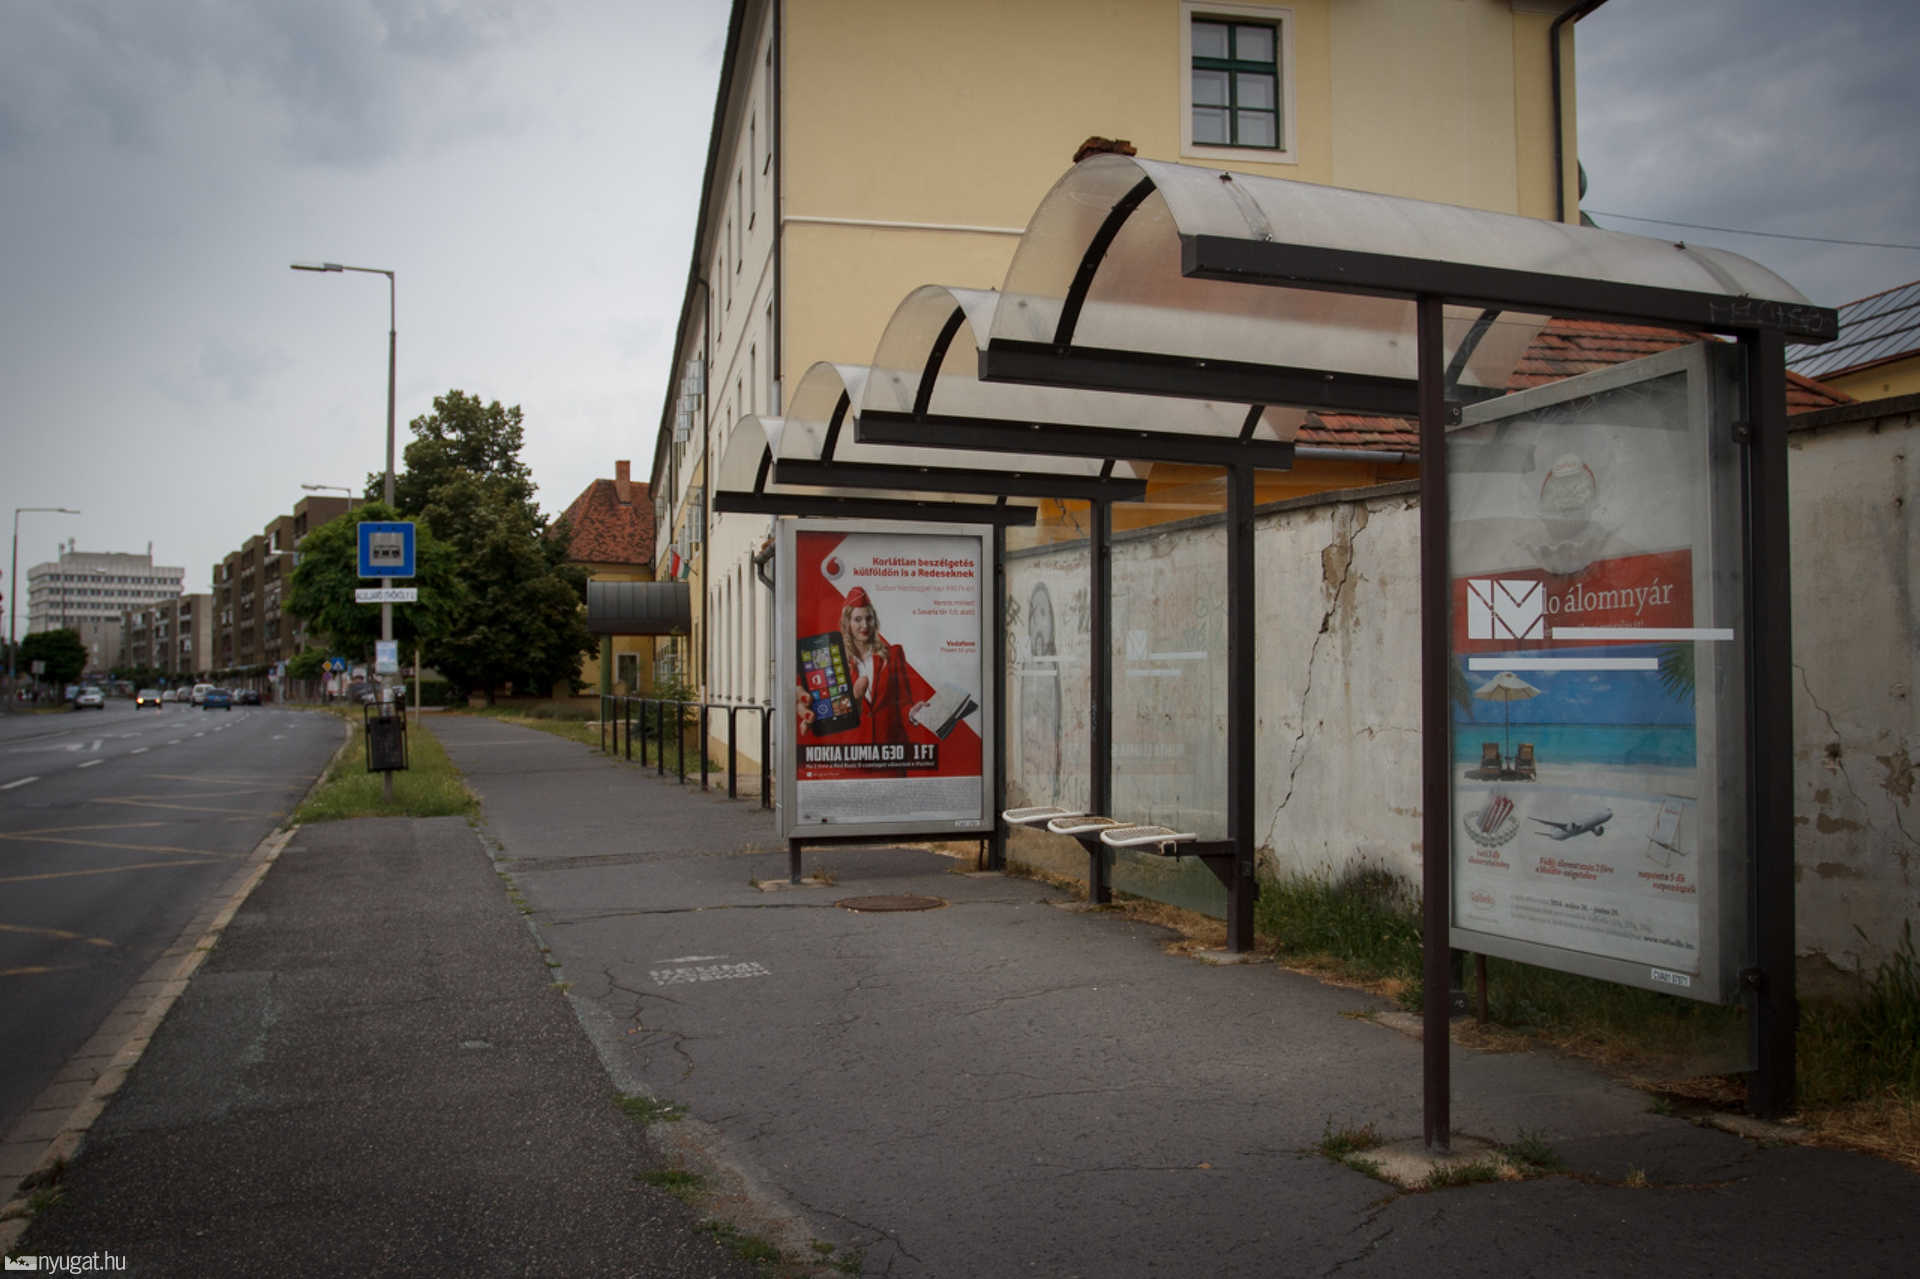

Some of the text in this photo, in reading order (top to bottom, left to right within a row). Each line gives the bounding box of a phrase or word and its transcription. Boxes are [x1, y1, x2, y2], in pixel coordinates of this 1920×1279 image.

[872, 557, 975, 569] Korlátlan beszélgetés
[853, 567, 899, 577] külföldön
[901, 568, 910, 577] is
[918, 568, 975, 578] Redeseknek
[1564, 577, 1673, 617] álomnyár
[806, 744, 935, 762] NOKIA LUMIA 630 1 FT
